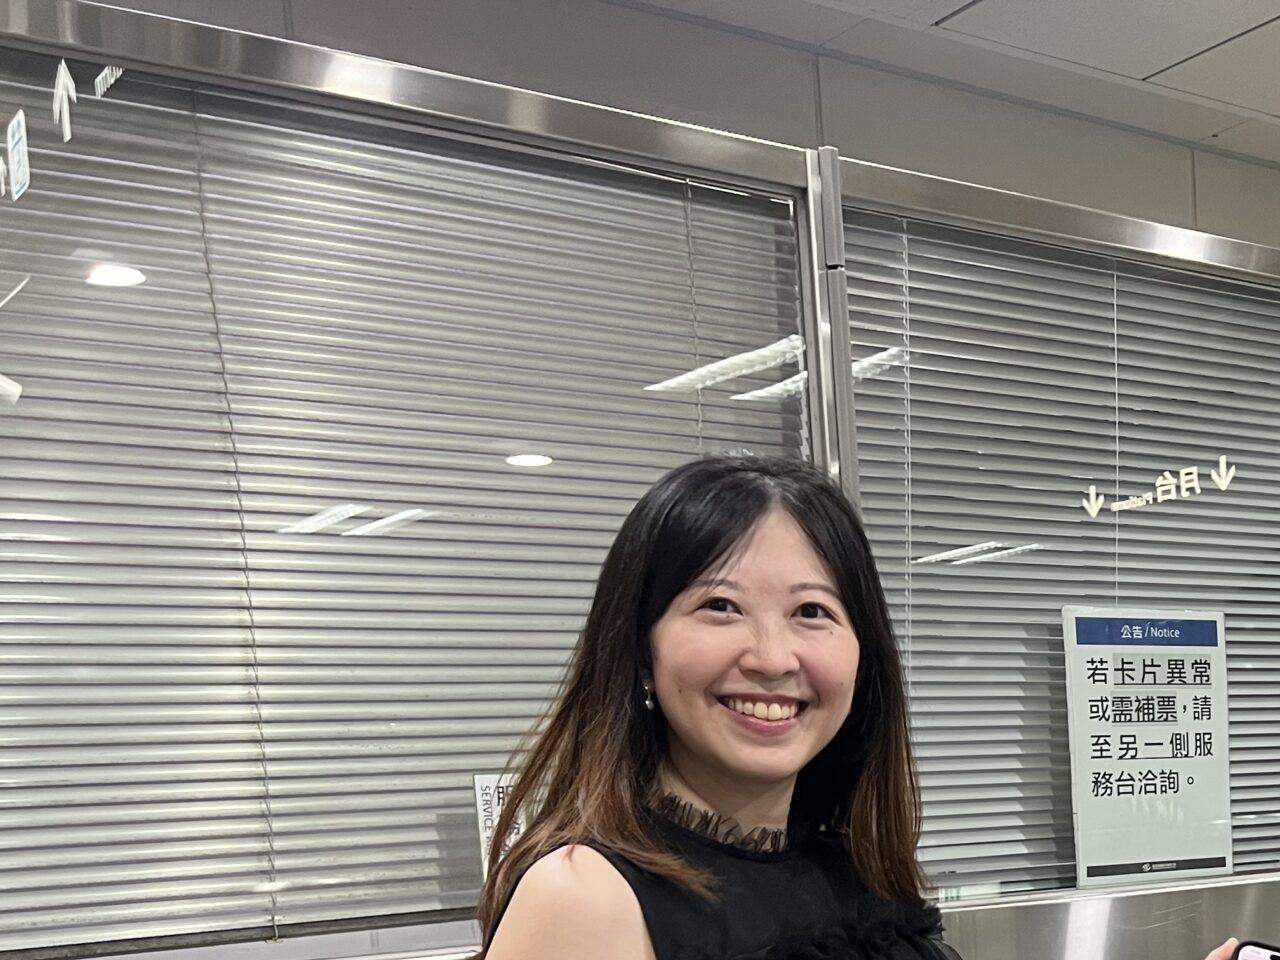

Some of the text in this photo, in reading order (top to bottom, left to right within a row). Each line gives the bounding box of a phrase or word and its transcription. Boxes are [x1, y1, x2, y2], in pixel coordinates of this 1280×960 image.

[1086, 658, 1211, 685] 若卡片異常
[1090, 732, 1213, 760] 至另一側服
[1091, 769, 1194, 797] 務台洽詢。
[481, 785, 494, 832] SERVICE
